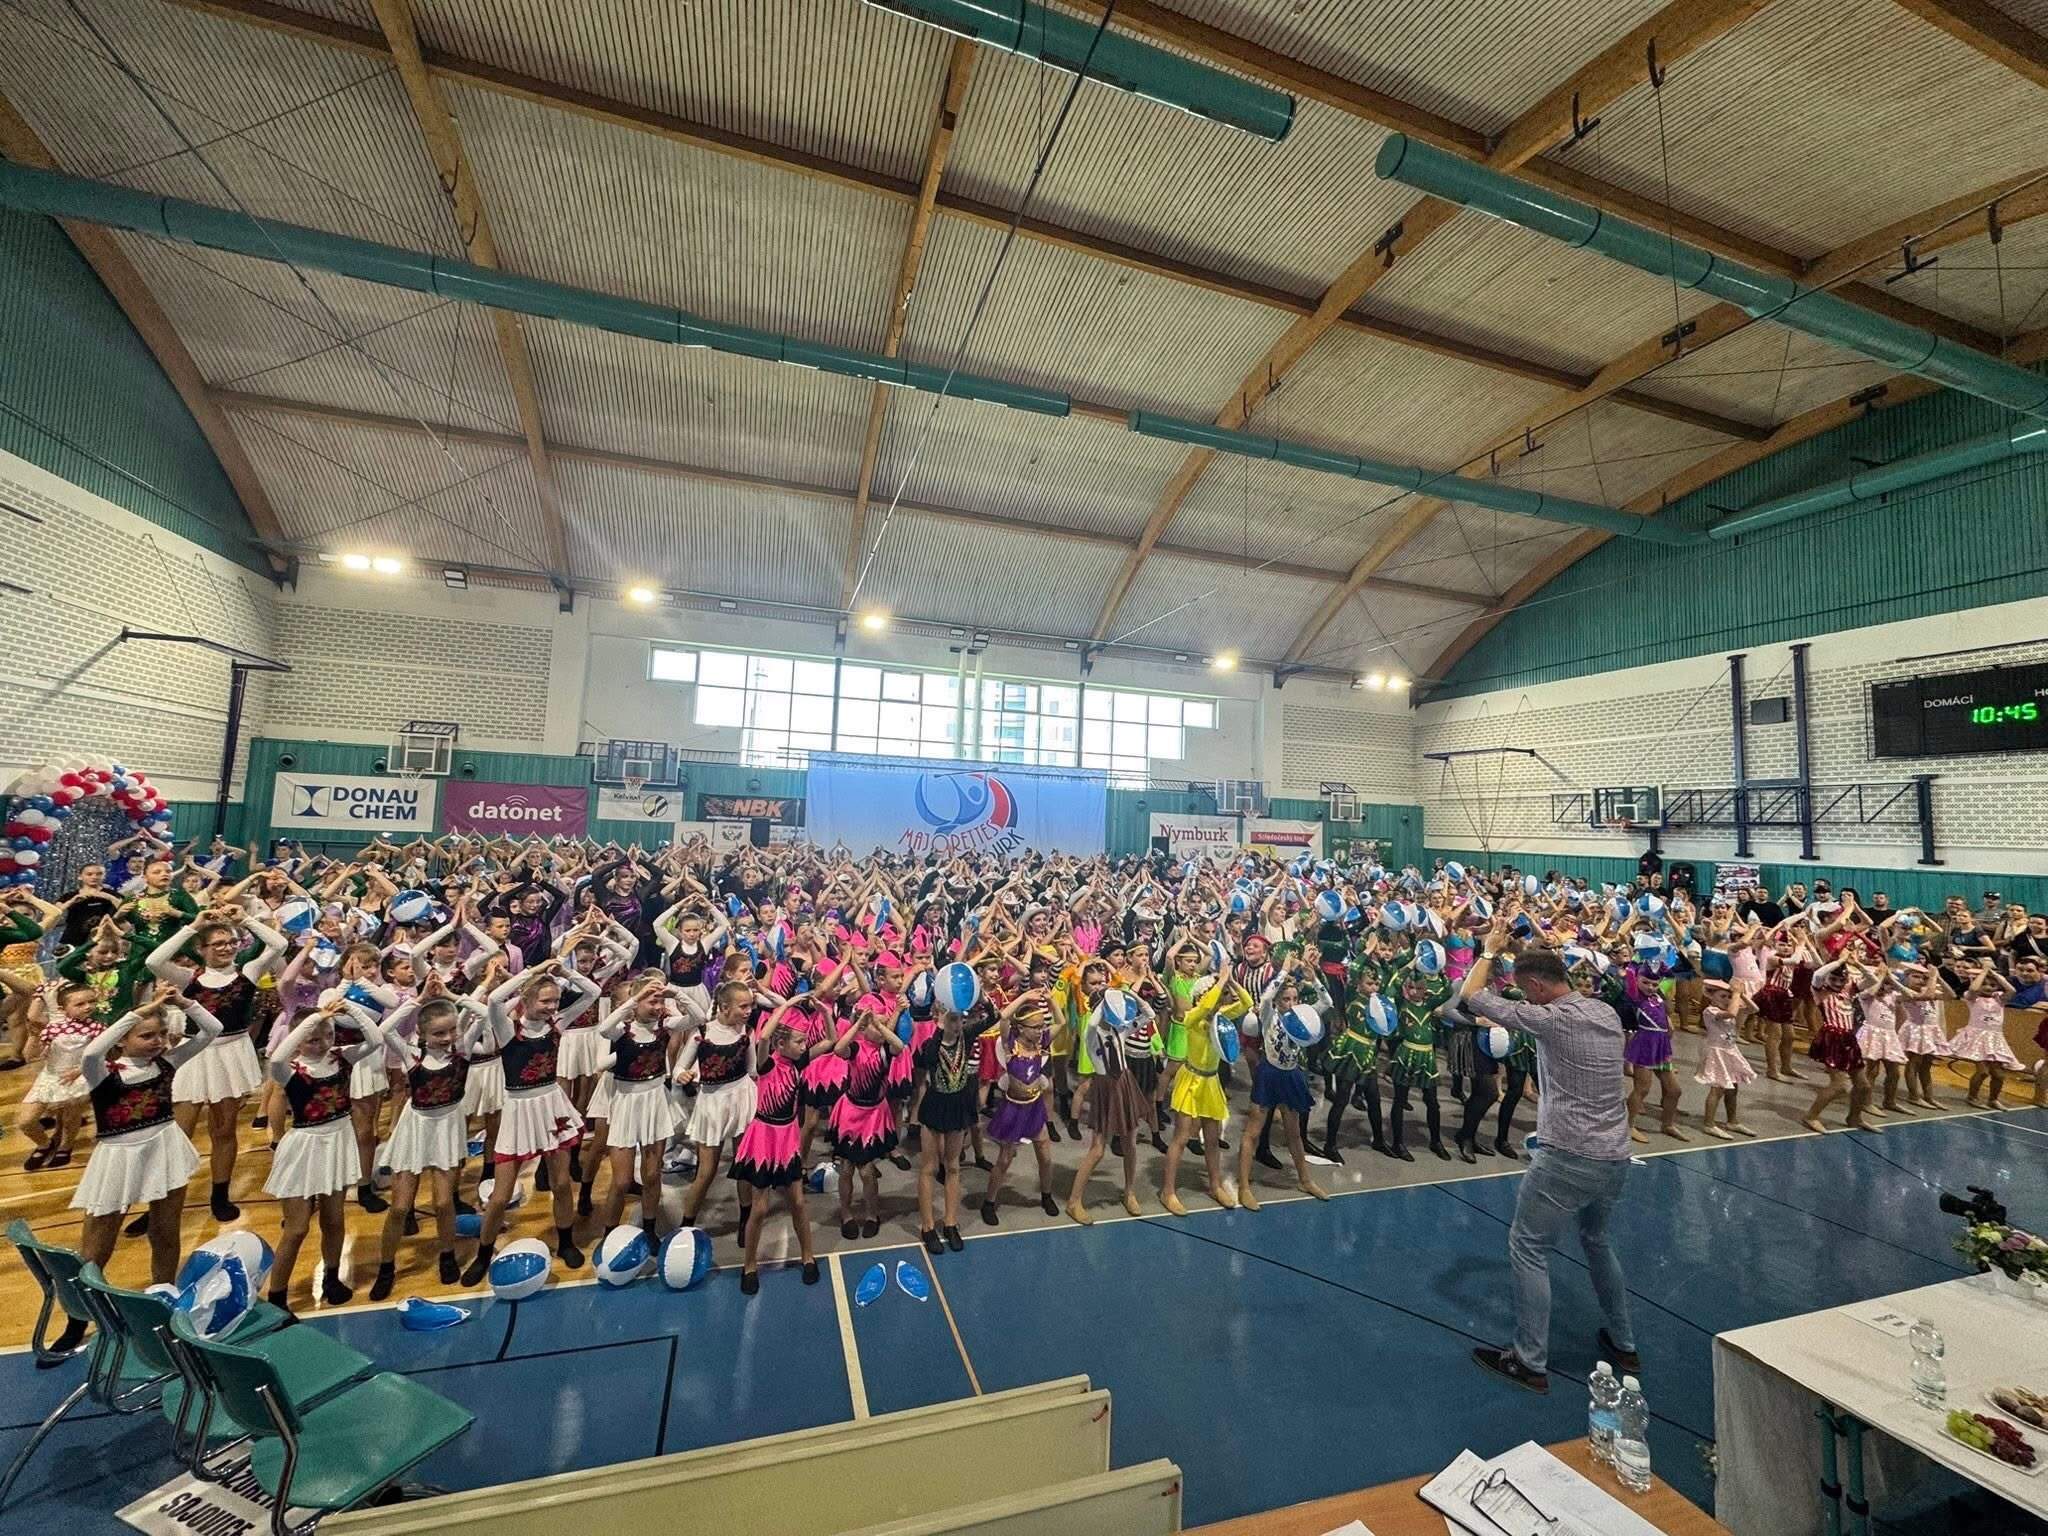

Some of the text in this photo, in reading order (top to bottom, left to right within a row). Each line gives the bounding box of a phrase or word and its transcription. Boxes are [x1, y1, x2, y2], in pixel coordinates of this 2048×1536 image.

[1972, 702, 2038, 723] 10:45
[333, 787, 418, 804] DONAU
[349, 804, 417, 821] CHEM
[468, 801, 562, 821] datonet
[732, 799, 786, 818] NBK
[898, 819, 999, 852] MAJORETTES
[1160, 824, 1228, 844] Nymburk
